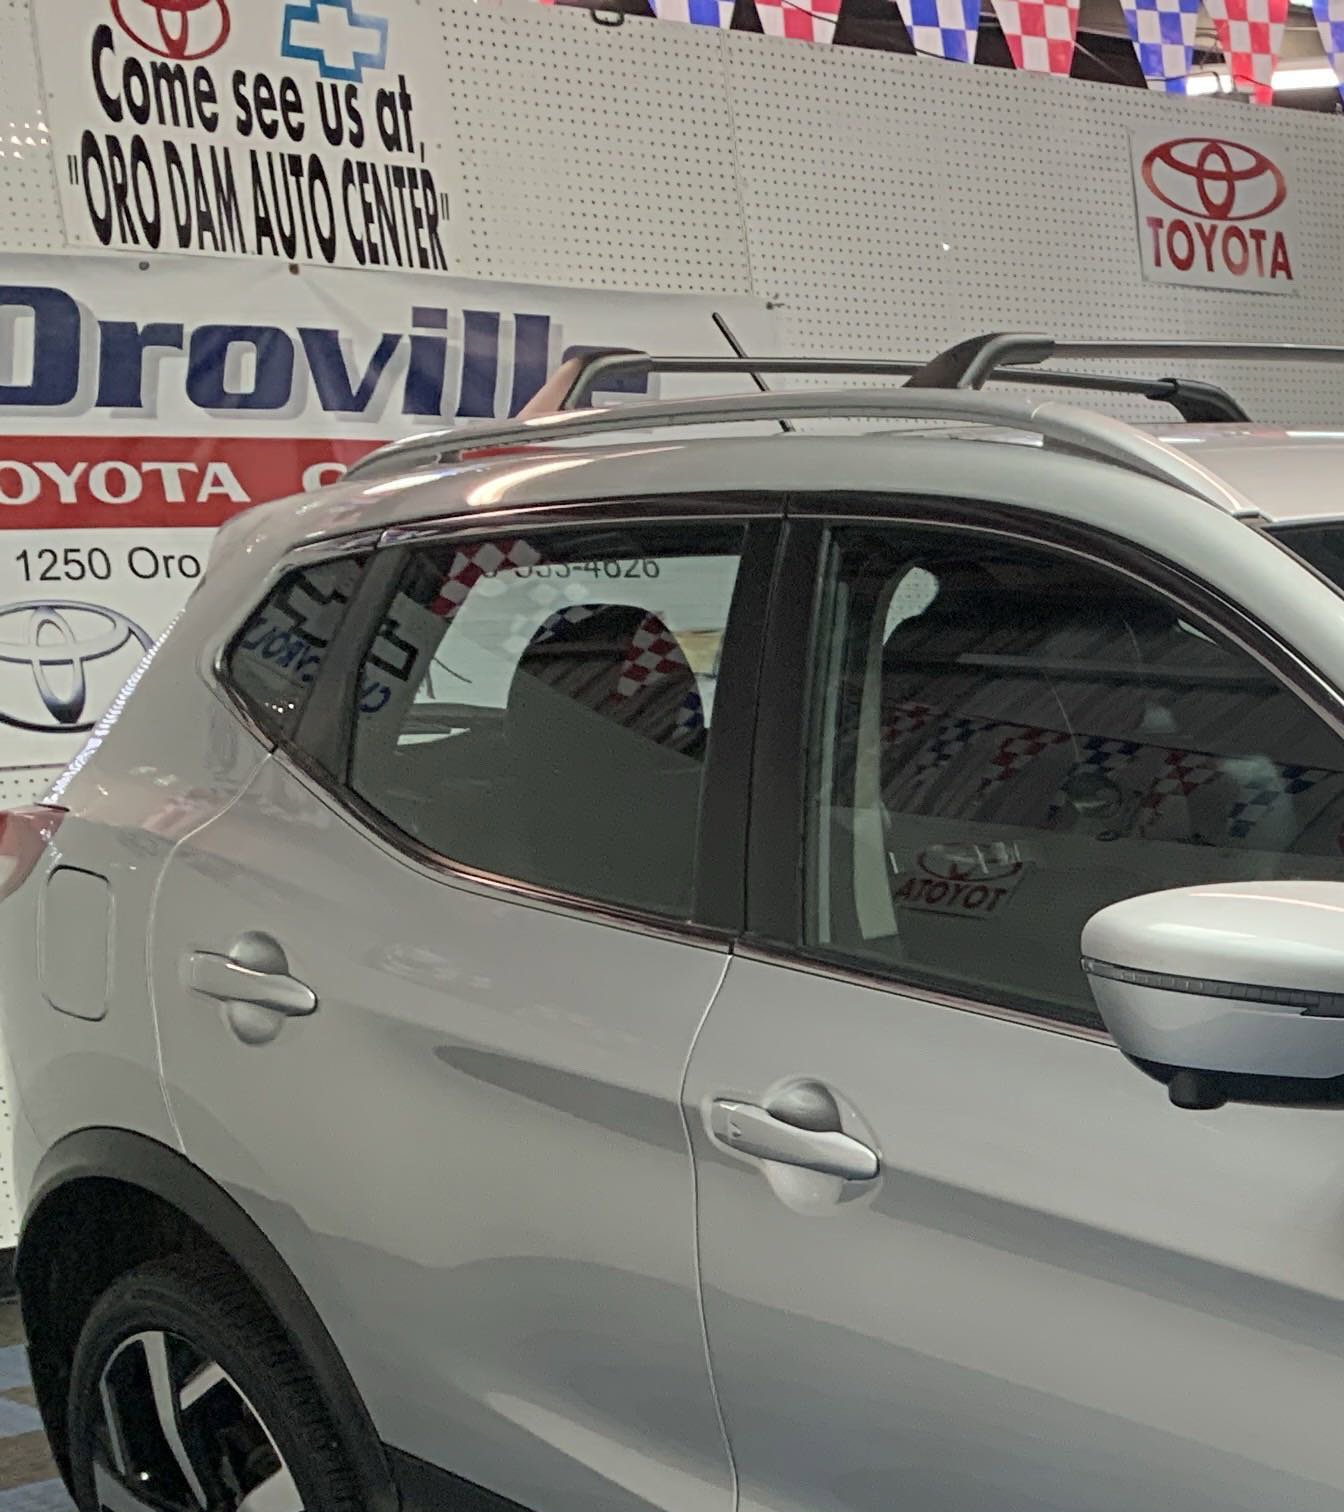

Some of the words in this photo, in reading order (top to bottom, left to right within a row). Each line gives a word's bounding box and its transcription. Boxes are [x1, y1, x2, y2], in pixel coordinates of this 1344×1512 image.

[91, 24, 219, 133] Come
[232, 70, 305, 142] see
[316, 81, 365, 148] us
[163, 140, 247, 255] DAM
[249, 149, 336, 264] AUTO
[1146, 217, 1293, 281] TOYOTA
[0, 460, 251, 506] OYOTA
[16, 547, 111, 581] 1250
[128, 547, 200, 579] Oro
